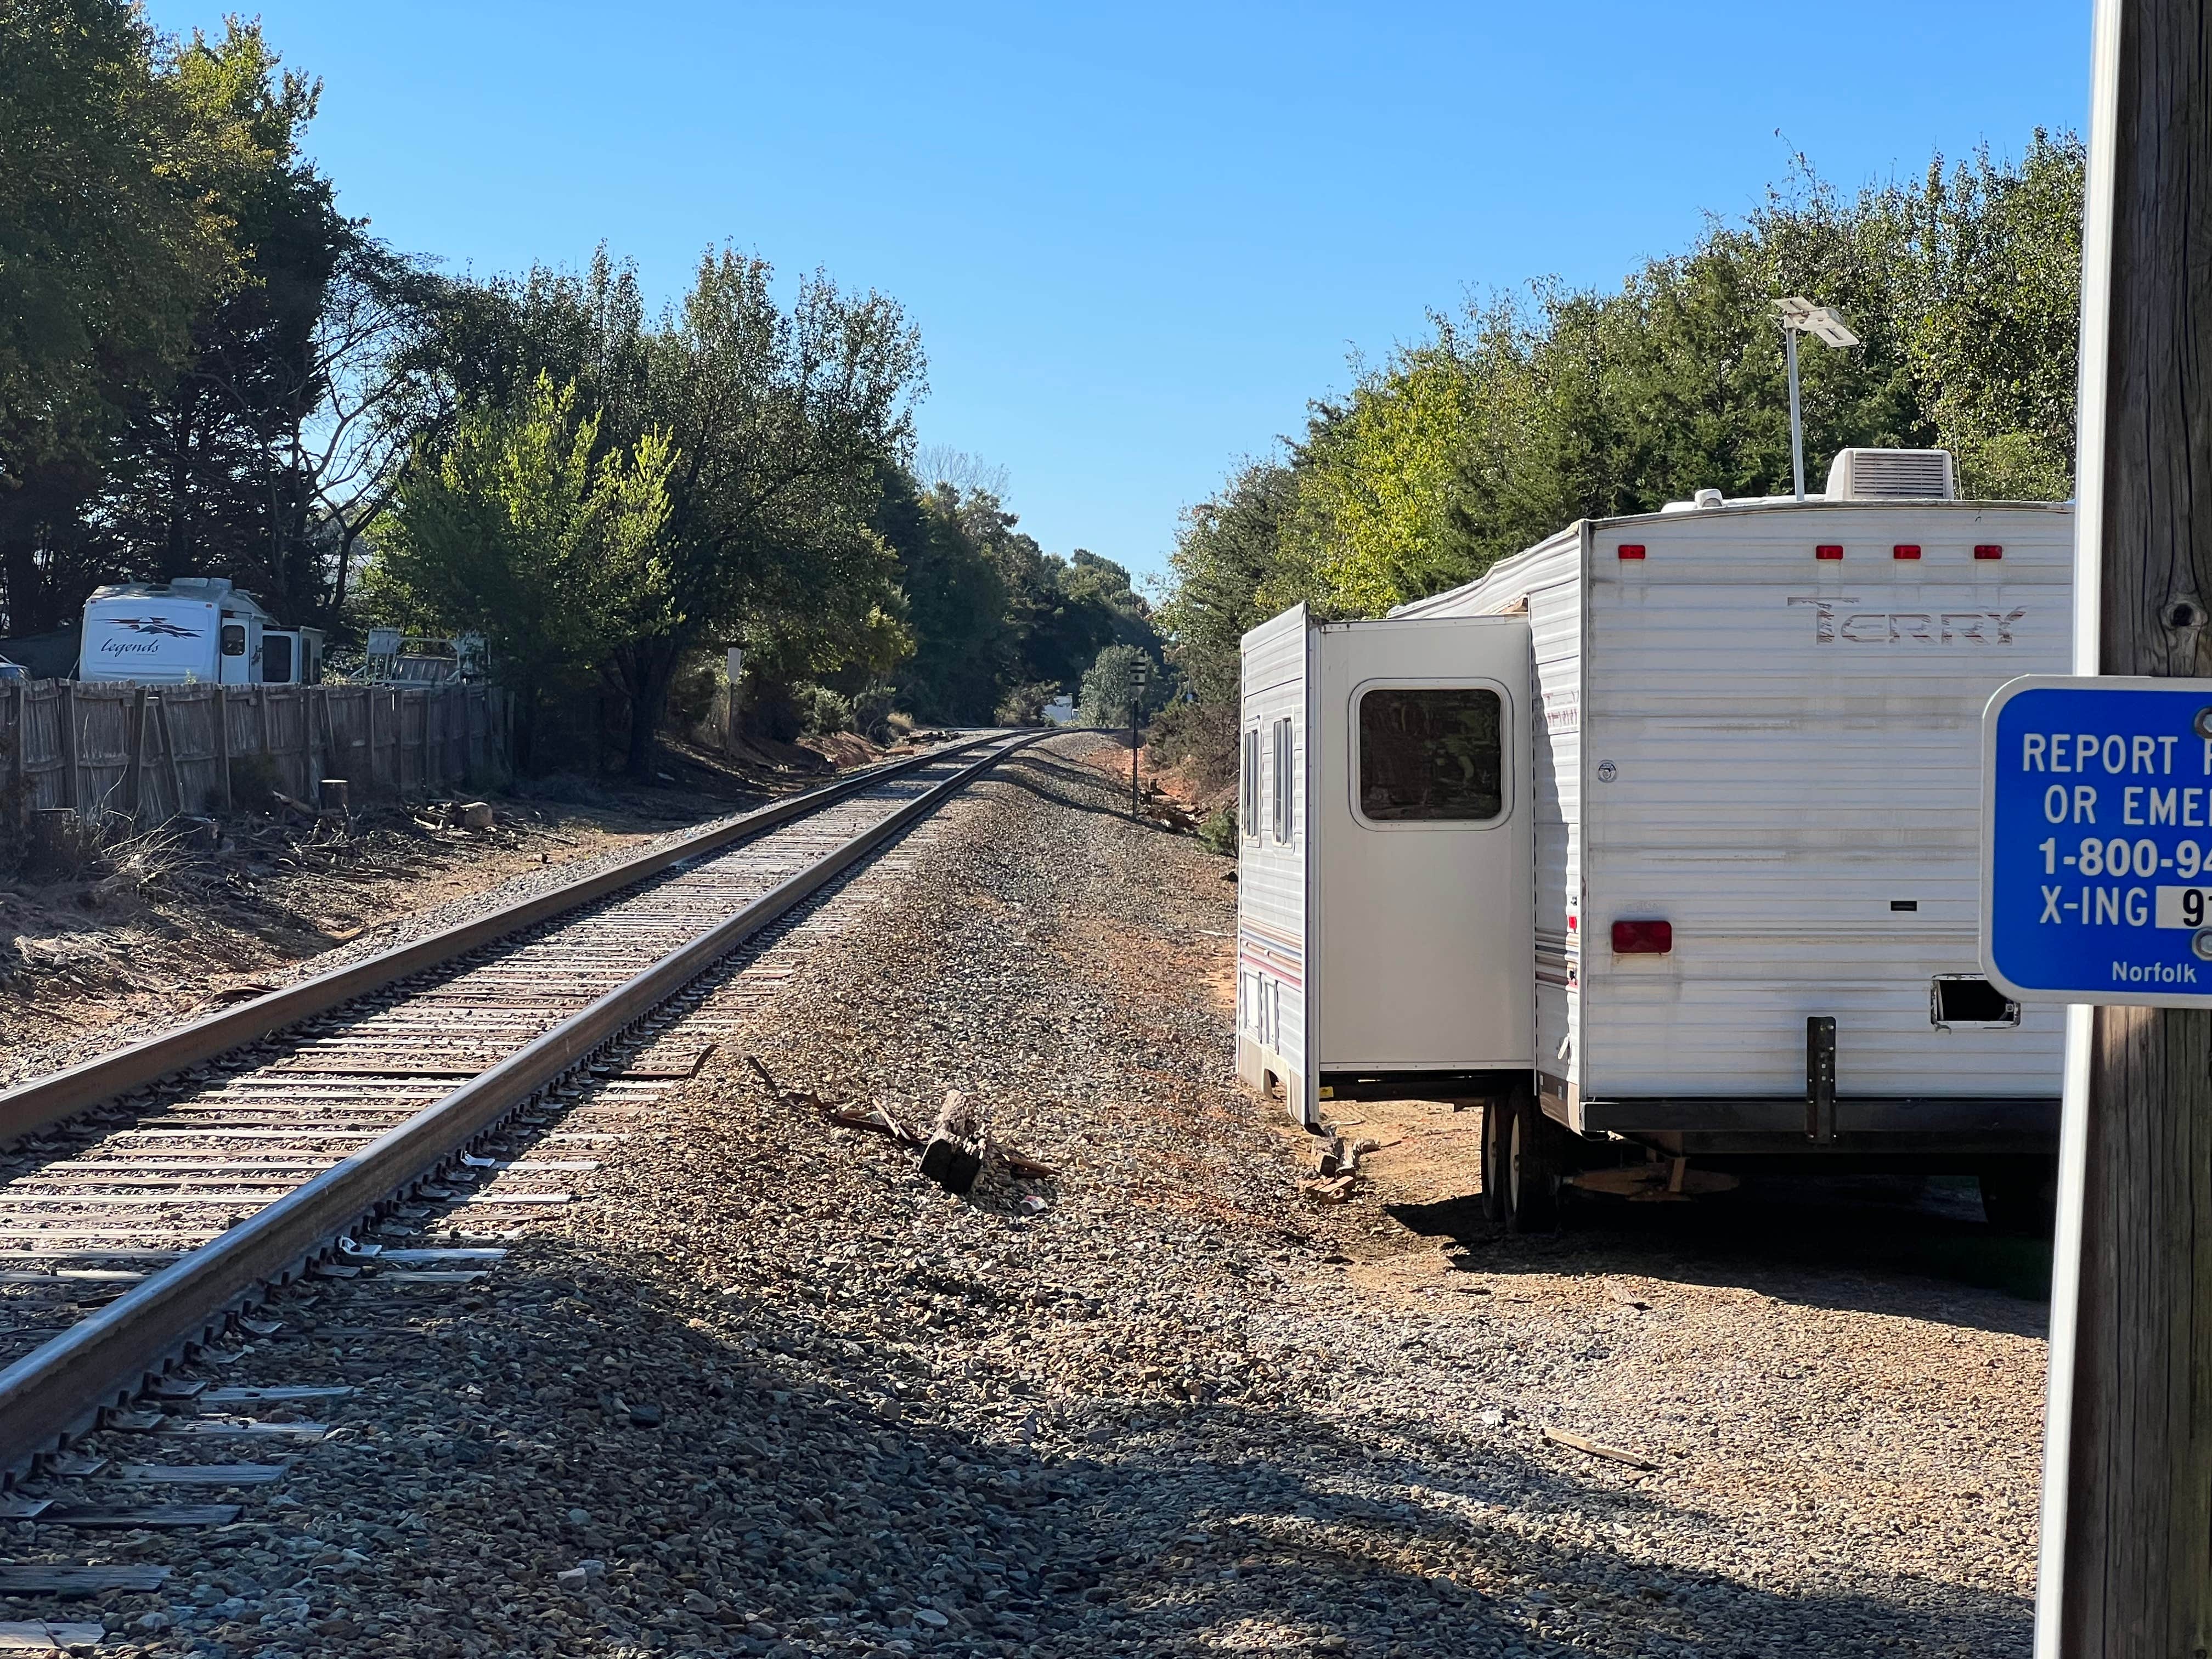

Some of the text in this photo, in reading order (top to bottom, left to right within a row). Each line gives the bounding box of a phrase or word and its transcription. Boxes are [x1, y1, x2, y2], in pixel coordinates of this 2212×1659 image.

[2023, 733, 2178, 775] REPORT
[2044, 785, 2212, 827] OR EME
[2039, 885, 2212, 928] X-ING 9
[2112, 961, 2197, 984] Norfolk
